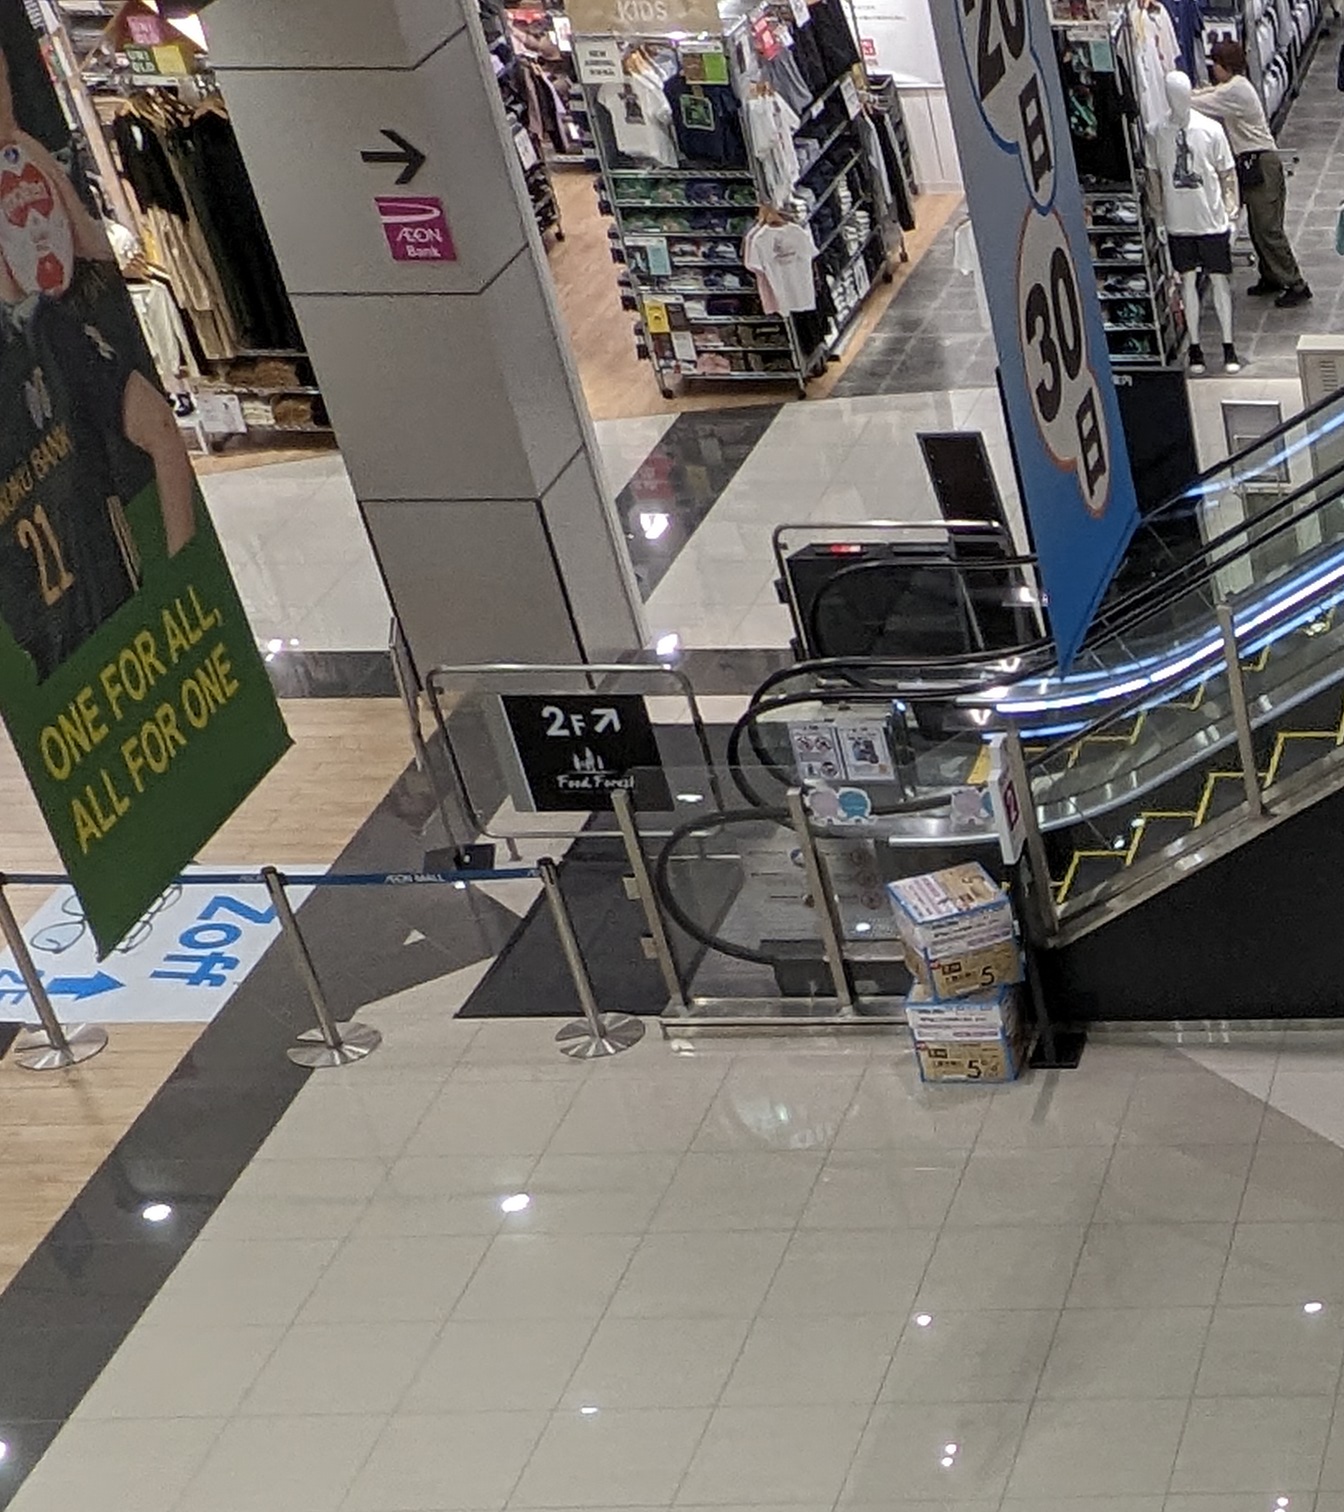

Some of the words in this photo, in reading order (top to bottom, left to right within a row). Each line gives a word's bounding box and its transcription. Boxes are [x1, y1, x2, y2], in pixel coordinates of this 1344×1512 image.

[616, 0, 669, 21] KIDS
[406, 244, 441, 257] Bank
[1025, 247, 1106, 498] 30日
[16, 504, 75, 606] 21
[40, 686, 110, 780] ONE
[100, 630, 167, 720] FOR
[162, 584, 224, 664] ALL,
[541, 706, 586, 737] 2F
[72, 769, 131, 854] ALL
[121, 703, 187, 793] FOR
[181, 642, 240, 729] ONE
